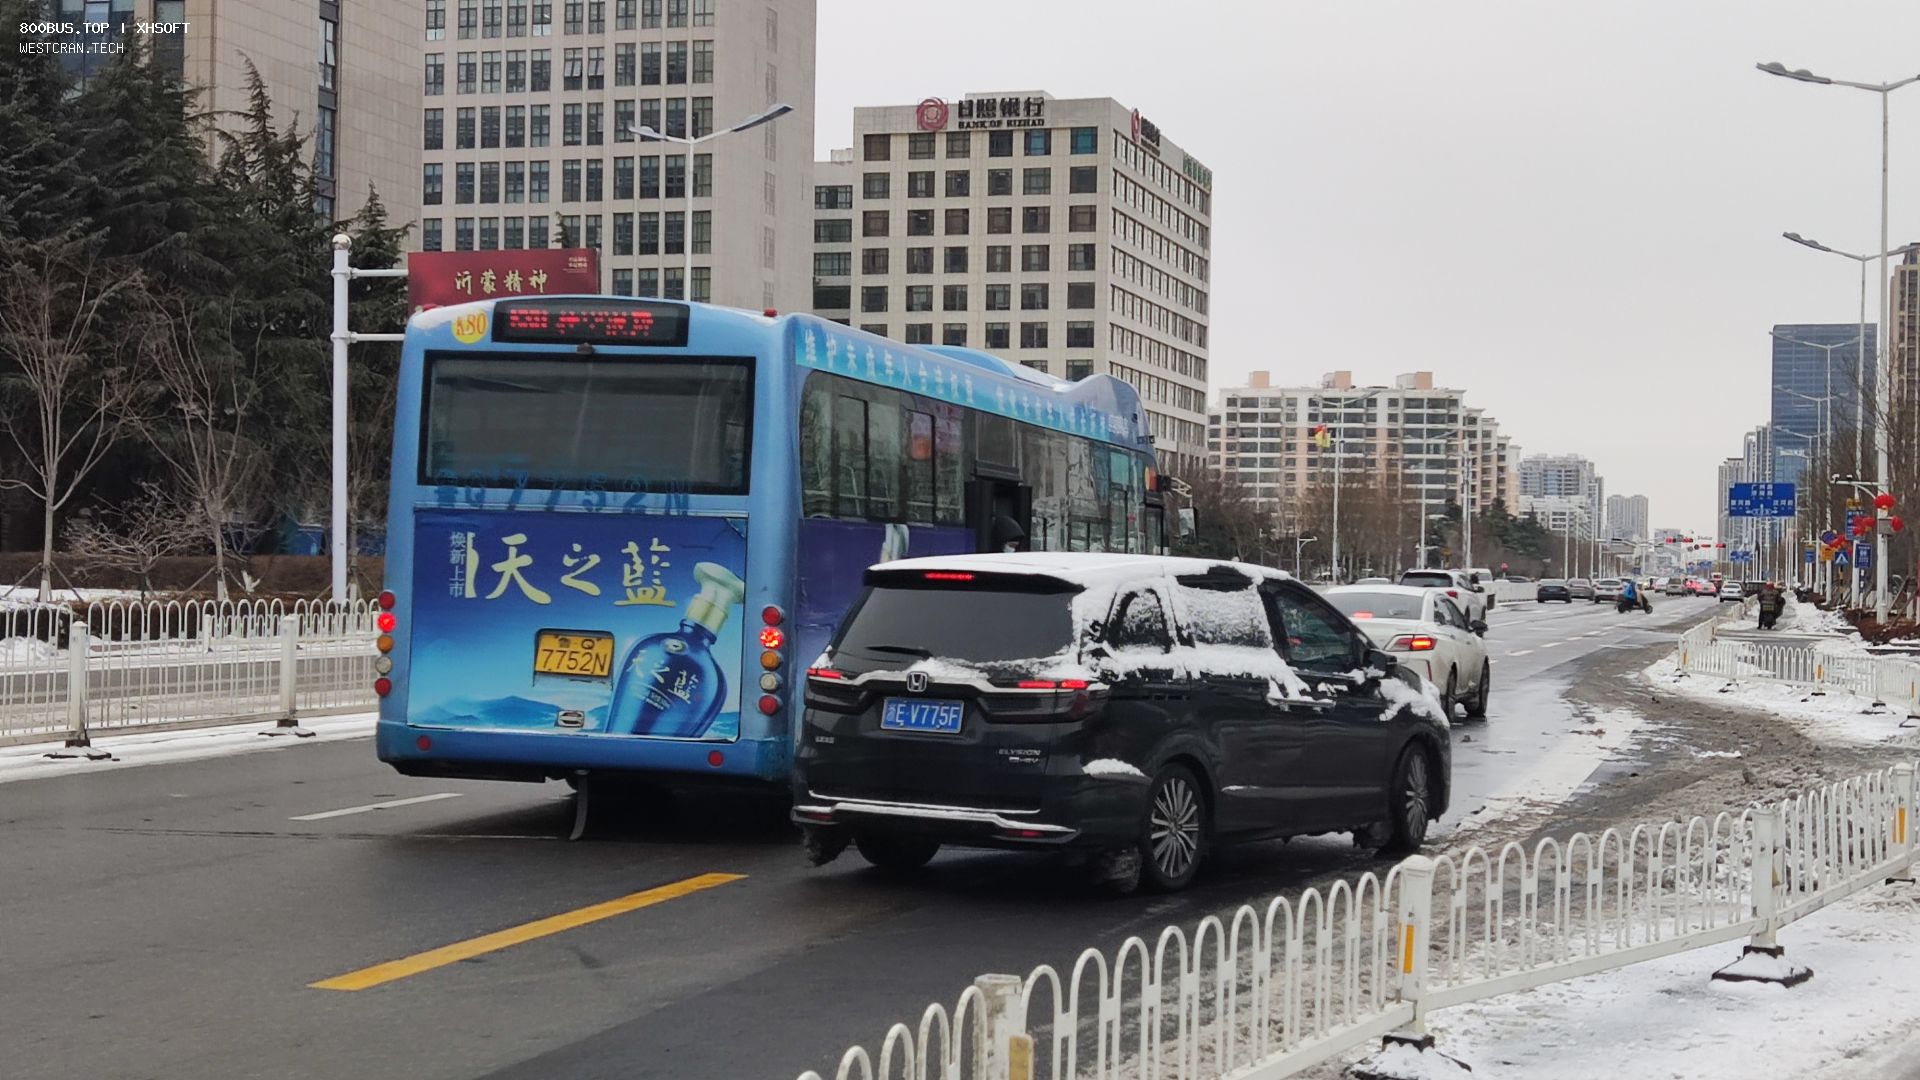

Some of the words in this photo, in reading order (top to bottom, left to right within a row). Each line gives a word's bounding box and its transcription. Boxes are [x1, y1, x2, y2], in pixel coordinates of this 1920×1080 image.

[958, 97, 1045, 118] 日照银行
[958, 120, 987, 129] BANK
[988, 119, 1002, 128] OF
[1007, 118, 1045, 128] RIZHAO
[454, 269, 548, 295] 沂蒙精神
[456, 312, 487, 336] K80
[542, 649, 608, 673] 7752N
